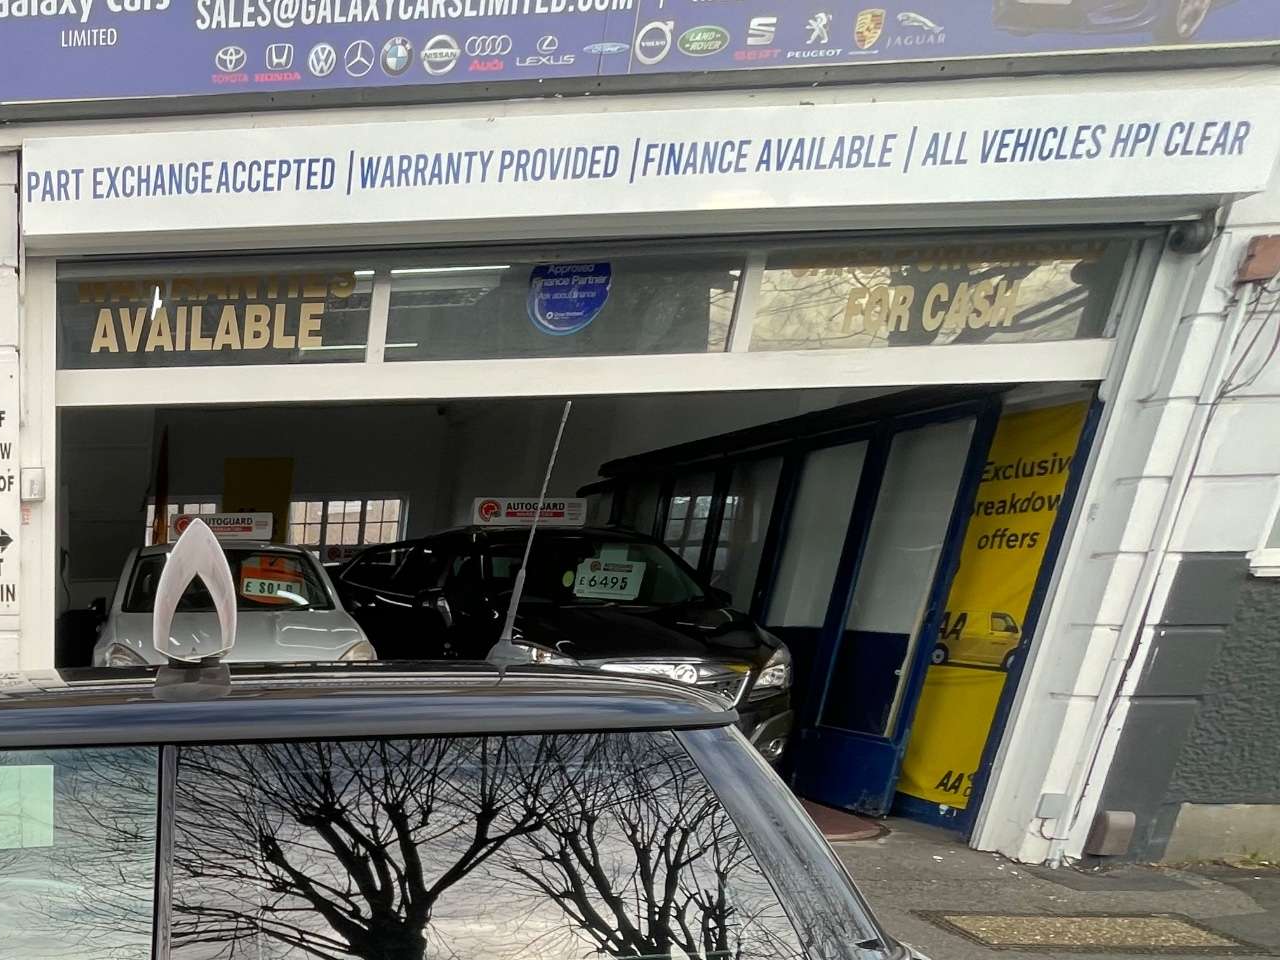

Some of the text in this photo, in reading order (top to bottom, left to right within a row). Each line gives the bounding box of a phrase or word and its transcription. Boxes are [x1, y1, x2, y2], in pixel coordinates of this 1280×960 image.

[61, 28, 118, 47] LIMITED
[887, 33, 946, 48] JAGUAR
[423, 51, 457, 59] NISSAN
[516, 55, 576, 66] LEXUS
[787, 49, 842, 58] PEUGEOT
[255, 72, 301, 82] HONDA
[26, 168, 84, 203] PART
[360, 150, 494, 190] WARRANTY
[498, 145, 620, 183] PROVIDED
[641, 138, 748, 177] FINANCE
[755, 133, 899, 172] AVAILABLE
[922, 130, 969, 166] ALL
[980, 124, 1107, 164] VEHICLES
[1112, 122, 1161, 158] HPI
[1164, 120, 1252, 156] CLEAR
[571, 275, 608, 285] Partner
[841, 279, 1022, 333] FOR CASH
[90, 302, 326, 353] AVAILABLE
[981, 453, 1072, 483] Exclusiv
[971, 491, 1061, 516] reakdow
[204, 517, 253, 525] UTOGUARD
[977, 528, 1040, 550] offers
[935, 770, 964, 795] AA
